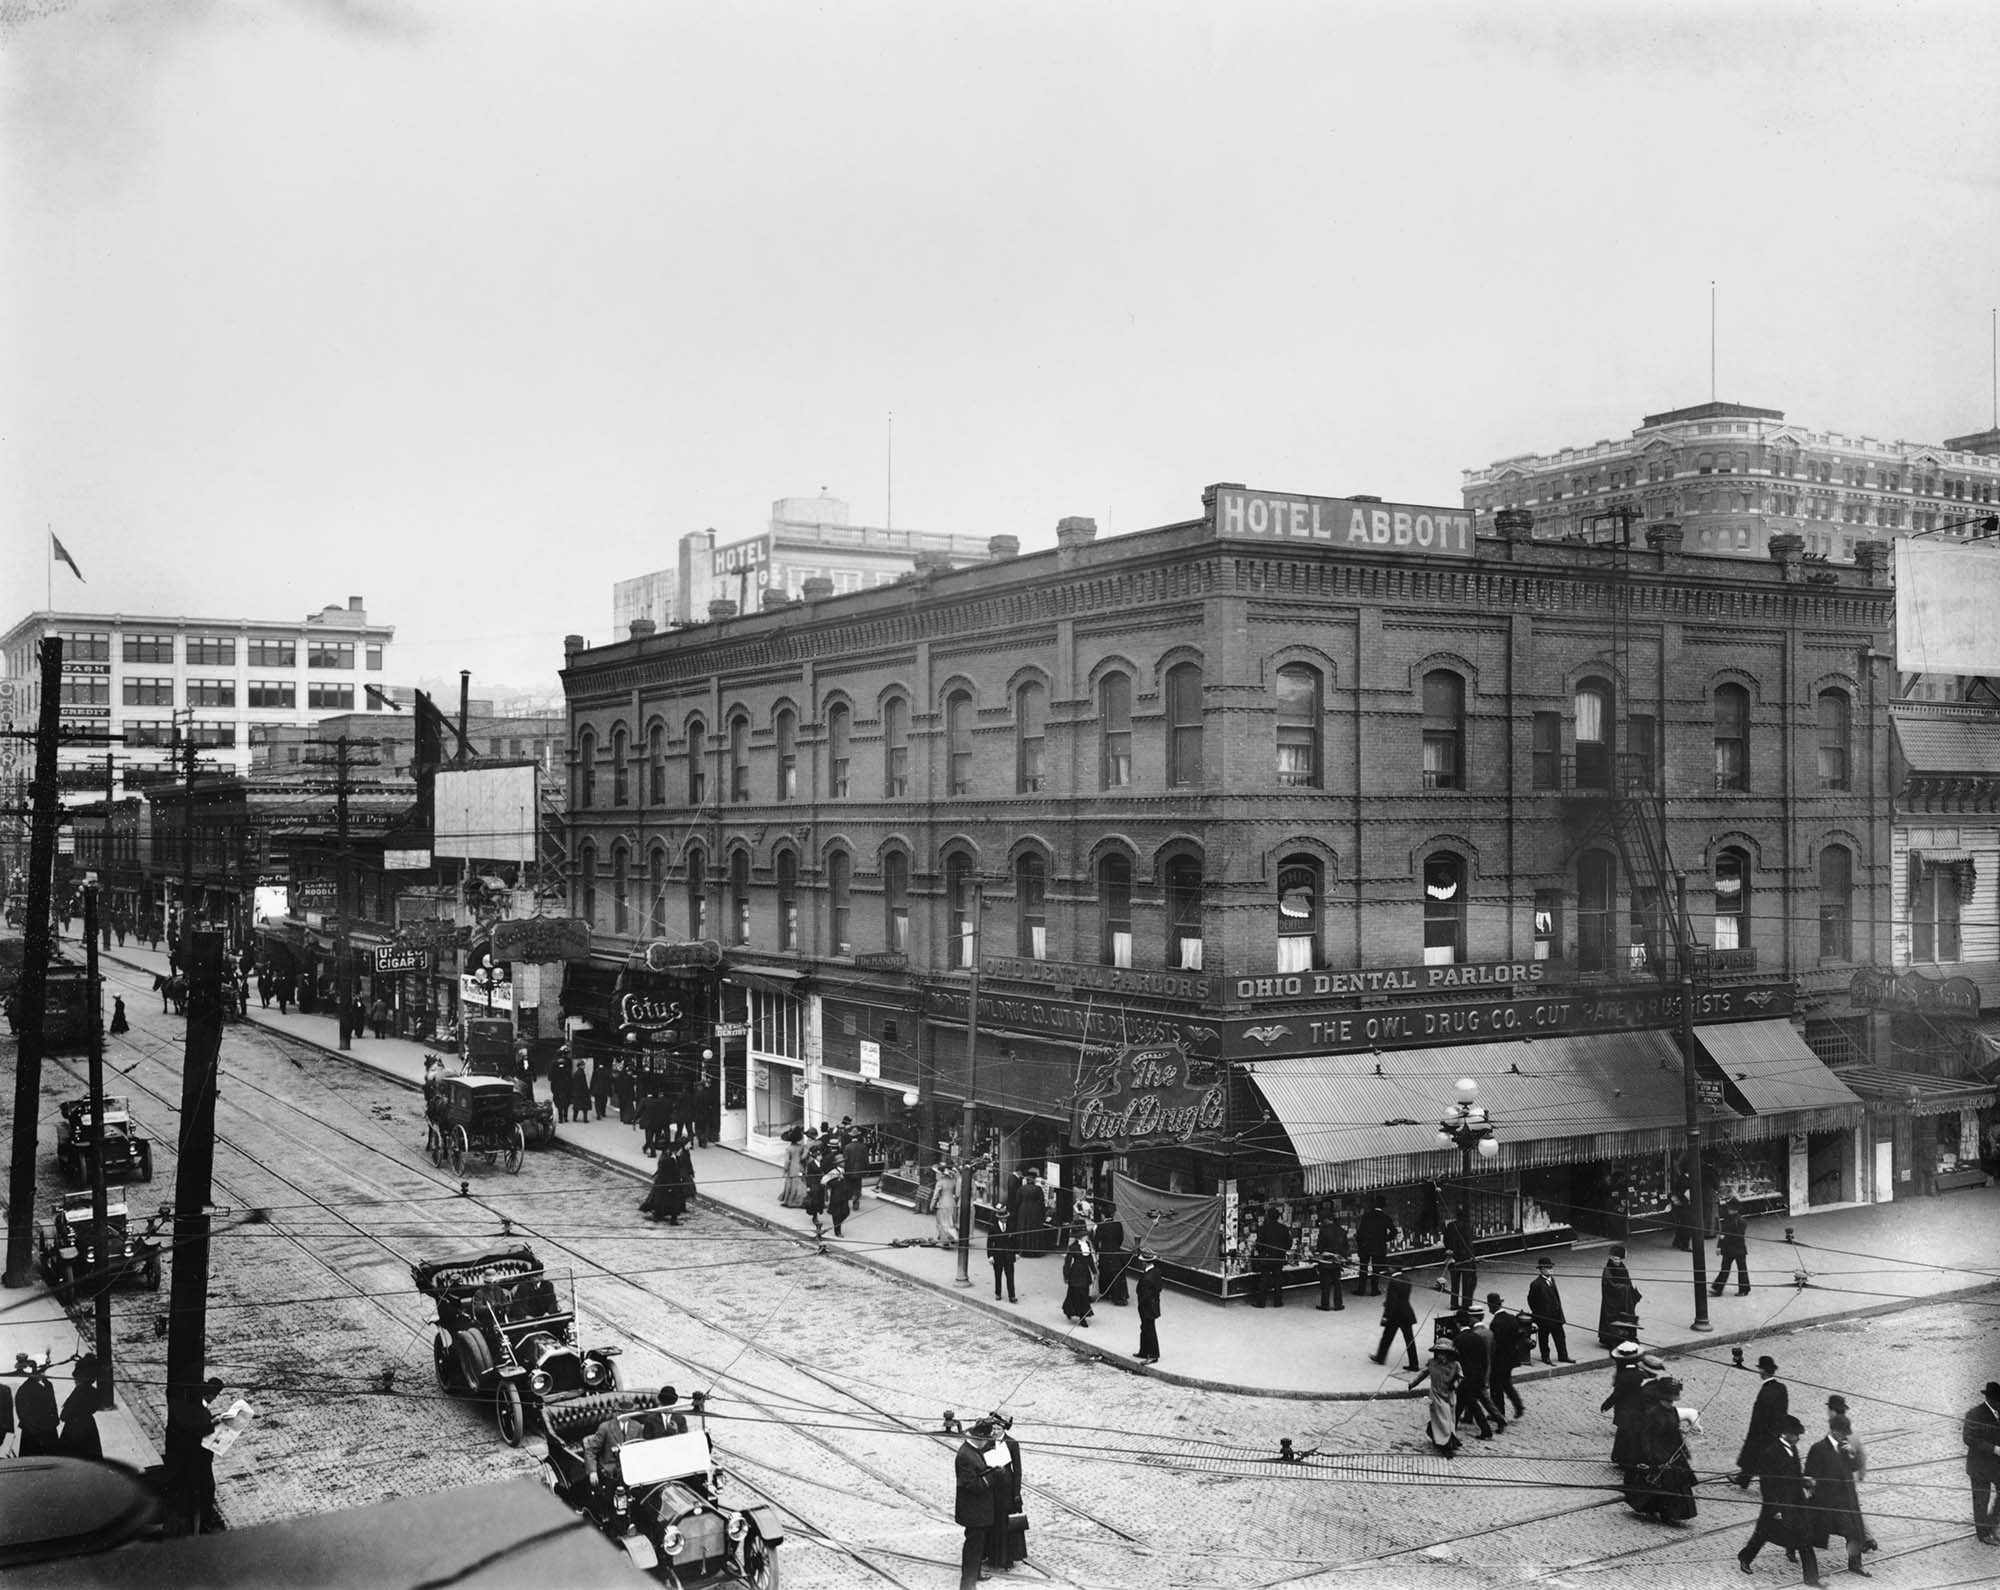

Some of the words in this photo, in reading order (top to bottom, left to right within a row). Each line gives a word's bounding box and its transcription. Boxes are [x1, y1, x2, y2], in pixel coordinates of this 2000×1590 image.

[1224, 495, 1331, 538] HOTEL
[1348, 508, 1470, 549] ABBOTT
[716, 541, 767, 574] HOTEL
[1280, 871, 1312, 887] OHIO
[984, 958, 1023, 980] OHIO
[1032, 964, 1101, 988] DENTAL
[1112, 971, 1208, 998] PARLORS
[1237, 977, 1302, 999] OHIO
[1314, 971, 1417, 995] DENTAL
[1428, 962, 1545, 988] PARLORS
[1000, 1000, 1027, 1023] DRUG
[1032, 1005, 1049, 1025] CO.
[1050, 1007, 1071, 1028] CUT
[1074, 1010, 1105, 1033] RATE
[1310, 1021, 1352, 1043] THE
[1366, 1015, 1413, 1039] OWL
[1425, 1010, 1479, 1034] DRUG
[1491, 1006, 1522, 1027] CO.
[1535, 1003, 1571, 1024] CUT
[1636, 993, 1731, 1018] DRUGISTS
[1131, 1052, 1177, 1089] The
[1081, 1097, 1140, 1139] Owl
[1130, 1094, 1199, 1142] Drug
